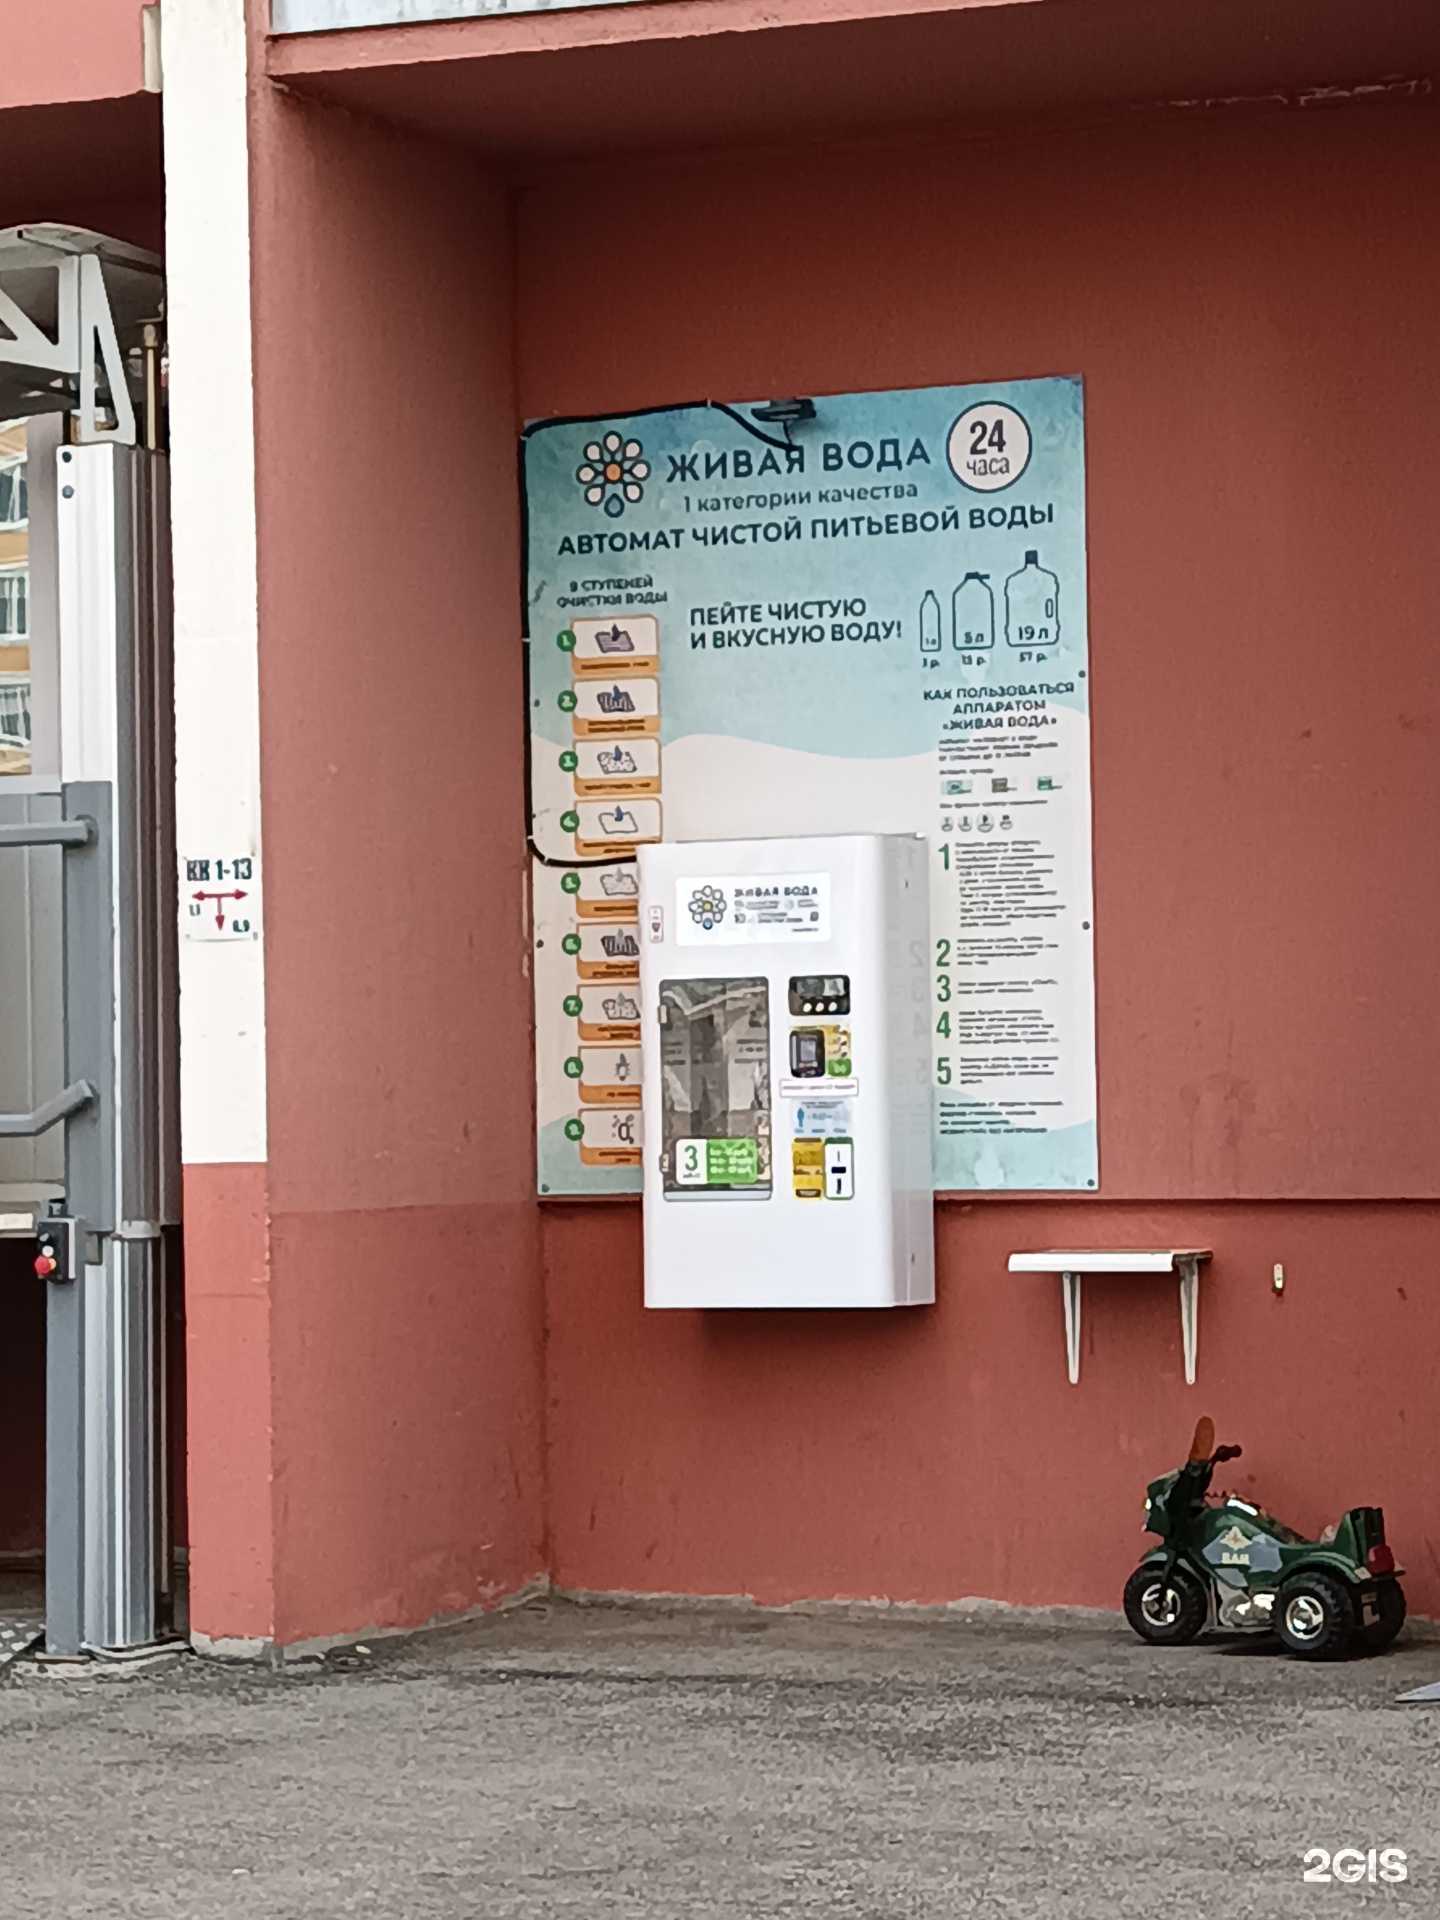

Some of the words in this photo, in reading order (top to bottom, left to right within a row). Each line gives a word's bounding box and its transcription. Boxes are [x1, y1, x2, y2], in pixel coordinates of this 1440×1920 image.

[969, 420, 1006, 455] 24
[666, 446, 805, 483] ЖИВАЯ
[822, 438, 931, 472] ВОДА
[966, 456, 1010, 477] часа
[684, 496, 691, 512] 1
[697, 490, 811, 513] категории
[818, 483, 918, 505] качества
[557, 528, 685, 556] АВТОМАТ
[692, 515, 802, 547] ЧИСТОЙ
[811, 506, 959, 539] ПИТЬЕВОЙ
[969, 502, 1054, 530] ВОДЫ
[626, 591, 668, 605] ВОДЫ
[690, 600, 763, 626] ПЕЙТЕ
[768, 598, 867, 622] ЧИСТУЮ
[690, 632, 706, 649] И
[712, 624, 826, 649] ВКУСНУЮ
[831, 620, 902, 643] ВОДУ!
[1018, 626, 1035, 640] 19
[1038, 627, 1049, 640] л
[923, 689, 952, 700] КАК
[956, 682, 1074, 699] ПОЛЬЗОВАТЬСЯ
[953, 700, 1046, 715] АППАРАТОМ
[215, 857, 252, 881] 1-13
[937, 843, 950, 871] 1
[935, 938, 951, 967] 2
[936, 974, 952, 1002] 3
[935, 1011, 952, 1039] 4
[937, 1057, 952, 1085] 5
[684, 1145, 698, 1172] 3
